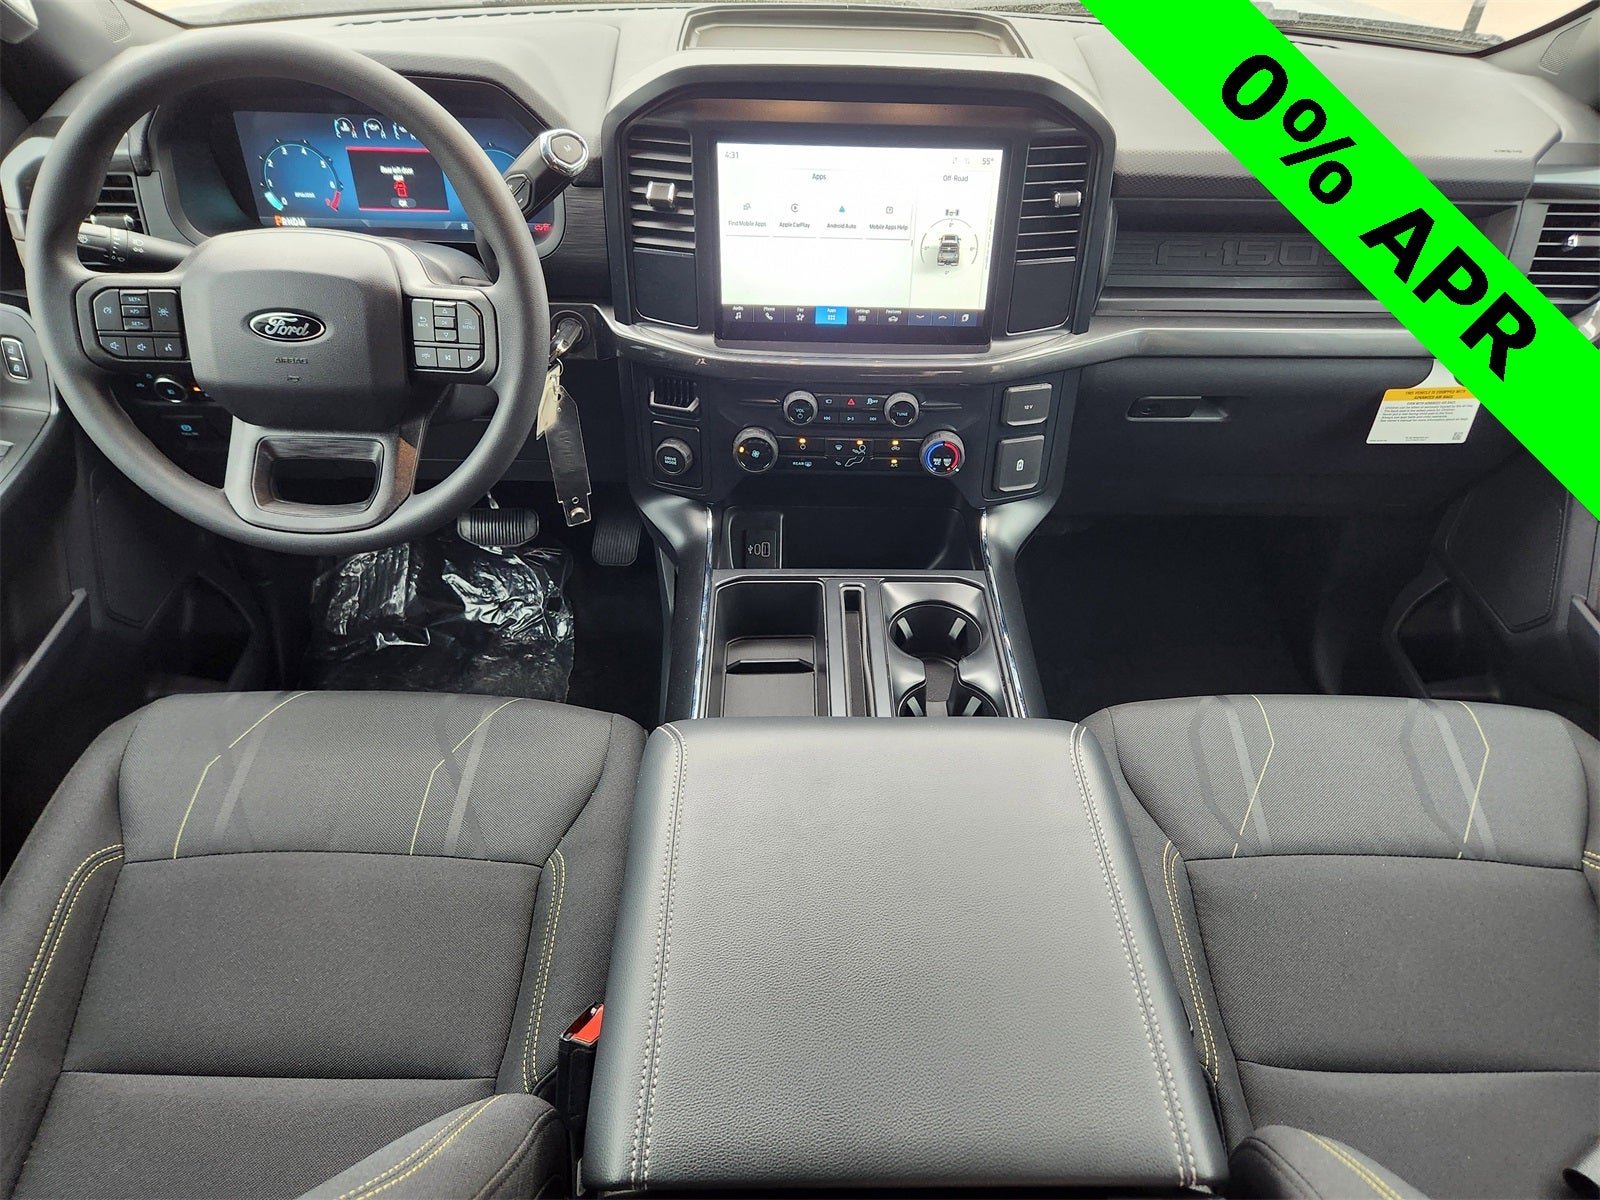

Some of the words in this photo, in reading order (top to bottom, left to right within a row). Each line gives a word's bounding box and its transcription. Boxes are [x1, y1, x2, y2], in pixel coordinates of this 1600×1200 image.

[724, 151, 739, 159] 4:31
[812, 173, 826, 181] Apps
[264, 316, 309, 337] Ford
